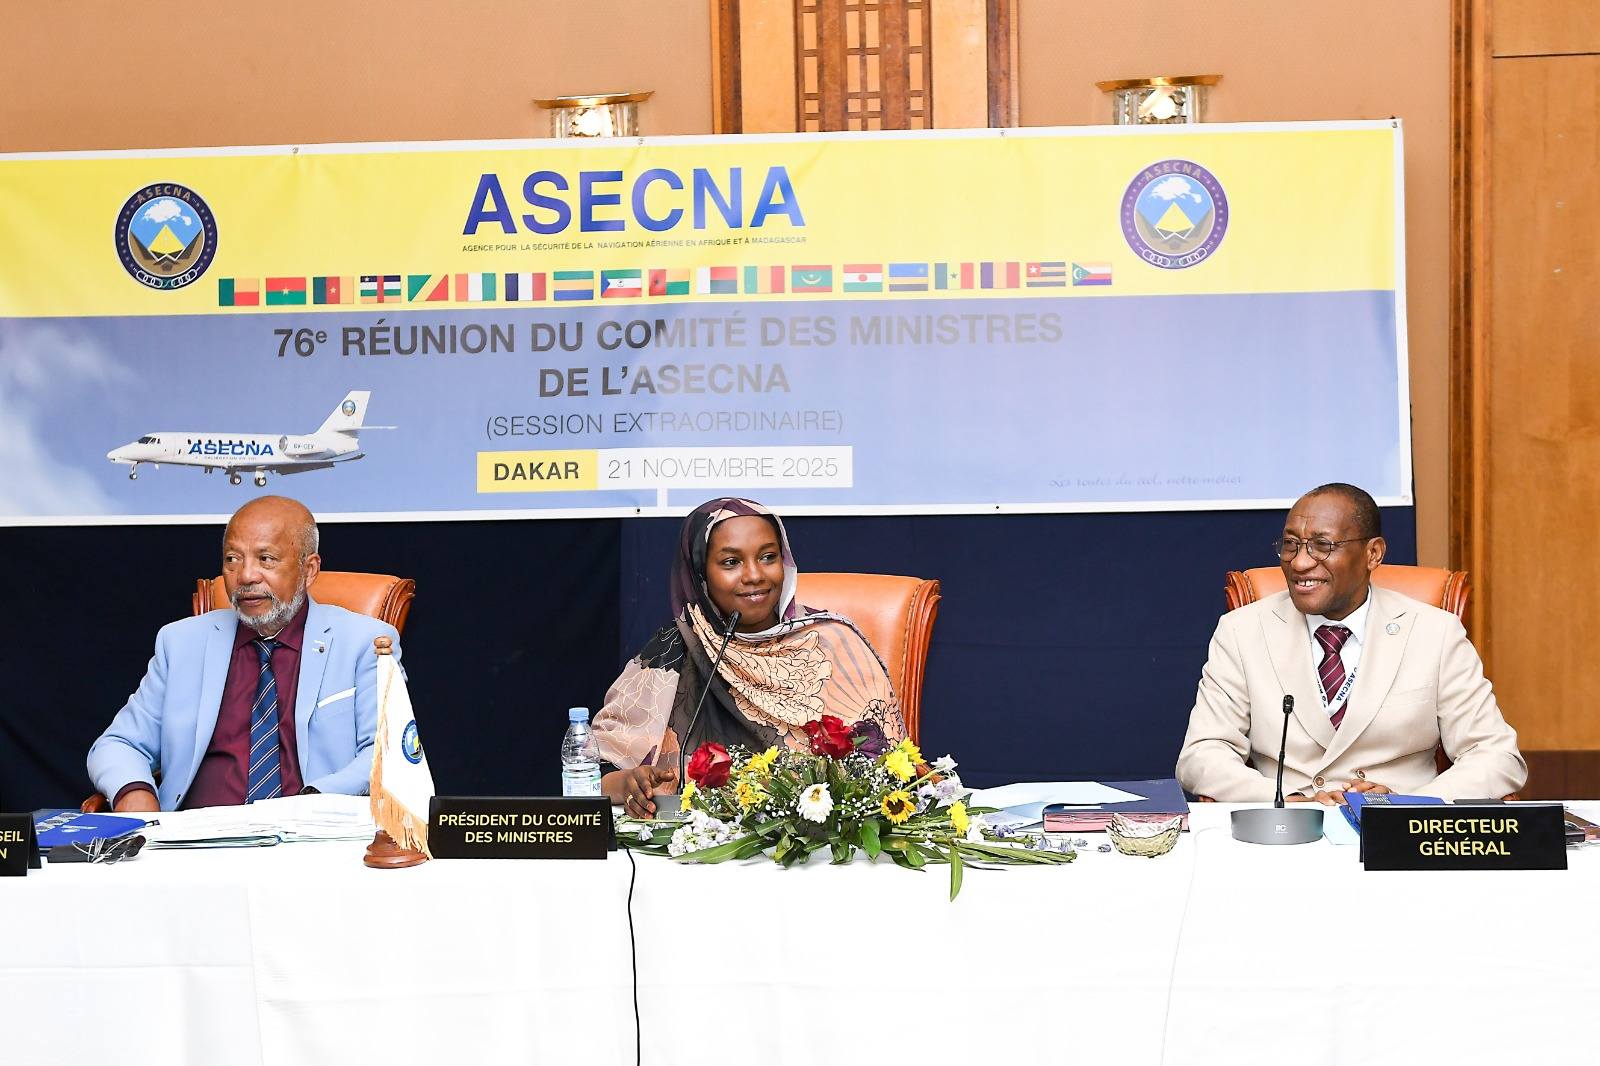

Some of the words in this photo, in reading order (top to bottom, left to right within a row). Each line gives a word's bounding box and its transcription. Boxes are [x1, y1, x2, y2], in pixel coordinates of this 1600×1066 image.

[1144, 161, 1202, 181] ASECNA
[136, 185, 191, 203] ASECNA
[462, 166, 806, 235] ASECNA
[462, 244, 493, 252] AGENCE
[495, 243, 517, 251] POUR
[520, 243, 531, 251] LA
[532, 241, 569, 251] SÉCURITÉ
[571, 242, 582, 250] DE
[597, 240, 644, 249] NAVIGATION
[645, 239, 684, 247] AÉRIENNE
[685, 239, 696, 247] EN
[699, 238, 731, 246] AFRIQUE
[744, 236, 750, 244] À
[751, 236, 807, 244] MADAGASCAR
[341, 318, 515, 356] RÉUNION
[531, 321, 583, 352] DU
[597, 310, 747, 350] COMITÉ
[760, 315, 837, 347] DES
[850, 312, 1063, 345] MINISTRES
[539, 367, 588, 397] DE
[486, 413, 602, 440] (SESSION
[613, 409, 844, 434] EXTRAORDINAIRE)
[188, 442, 274, 455] ASECNA
[493, 461, 580, 481] DAKAR
[608, 459, 632, 479] 21
[643, 456, 774, 479] NOVEMBRE
[782, 456, 838, 478] 2025
[1336, 672, 1355, 701] ASECNA
[438, 812, 518, 826] PRÉSIDENT
[522, 814, 543, 826] DU
[547, 811, 601, 826] COMITÉ
[1408, 818, 1519, 834] DIRECTEUR
[465, 831, 493, 843] DES
[497, 831, 573, 843] MINISTRES
[1419, 837, 1511, 855] GÉNÉRAL
